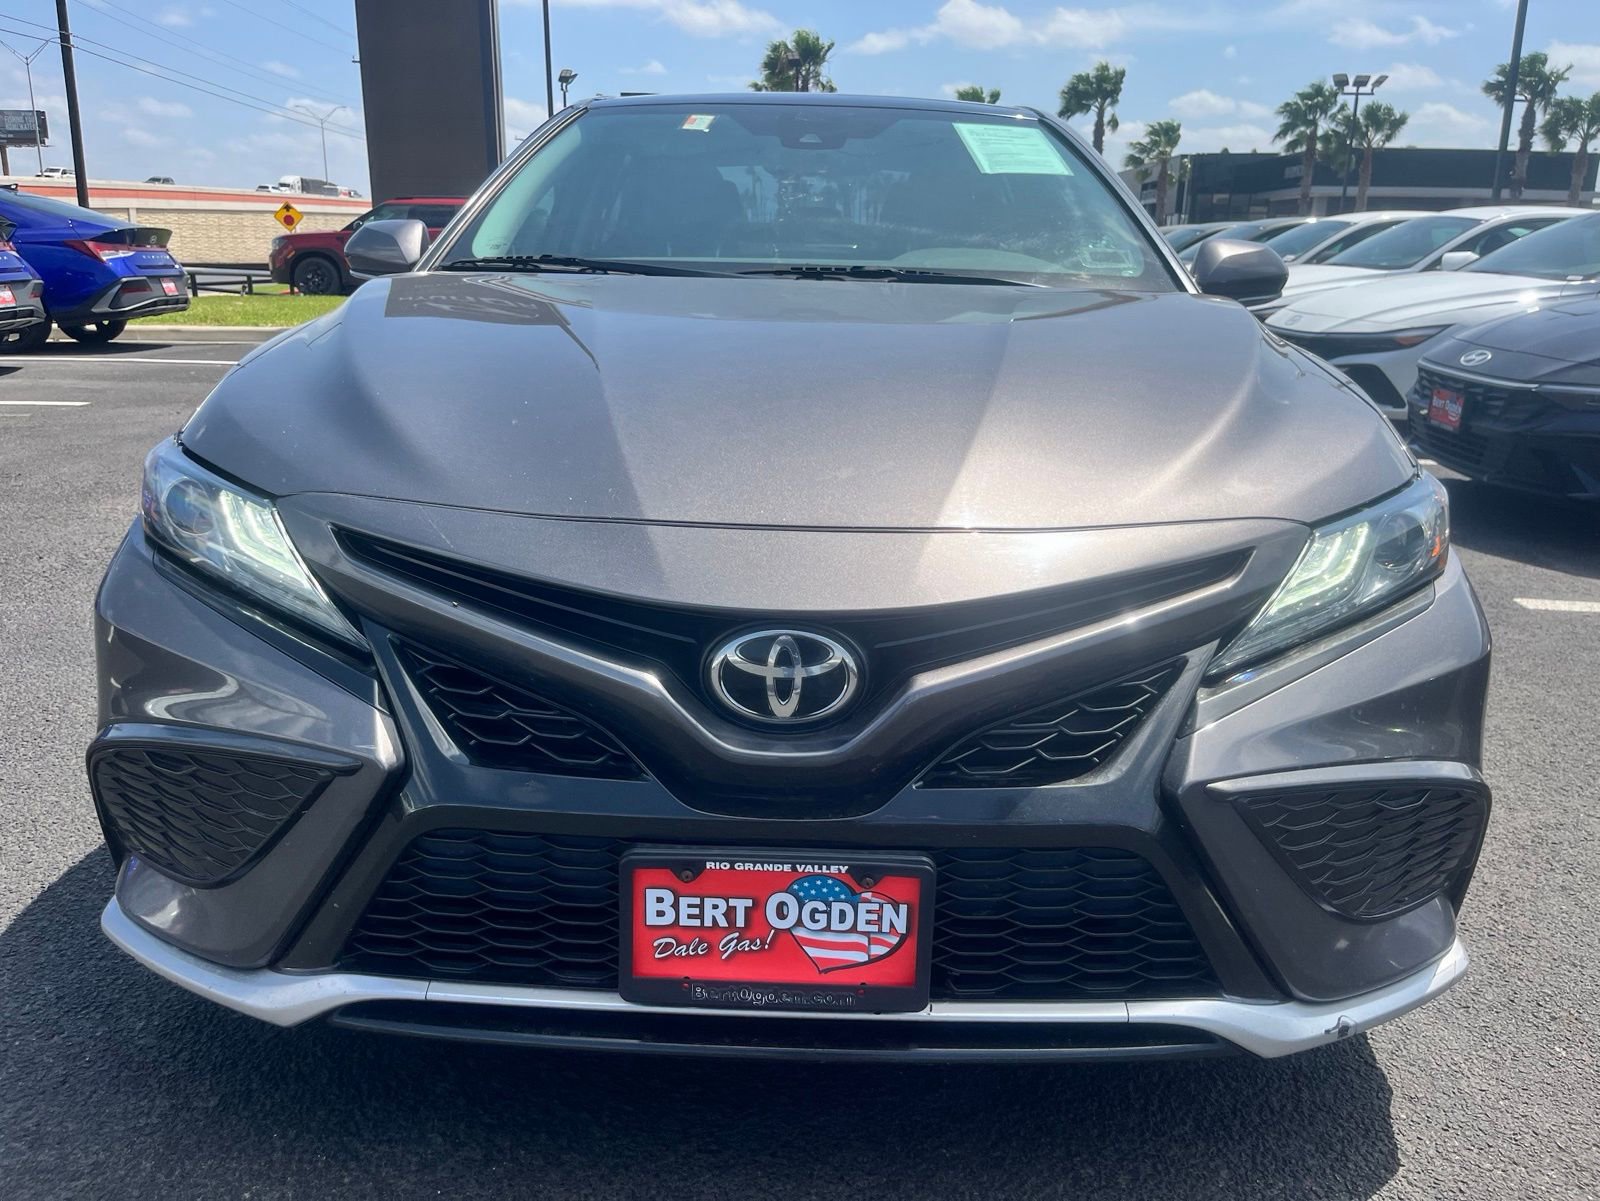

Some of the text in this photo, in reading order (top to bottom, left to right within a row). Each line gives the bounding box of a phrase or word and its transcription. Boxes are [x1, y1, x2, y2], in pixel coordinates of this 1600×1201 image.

[706, 861, 849, 874] RIO GRANDE VALLEY
[645, 888, 908, 934] BERT OGDEN
[653, 929, 775, 960] Dale Gas!
